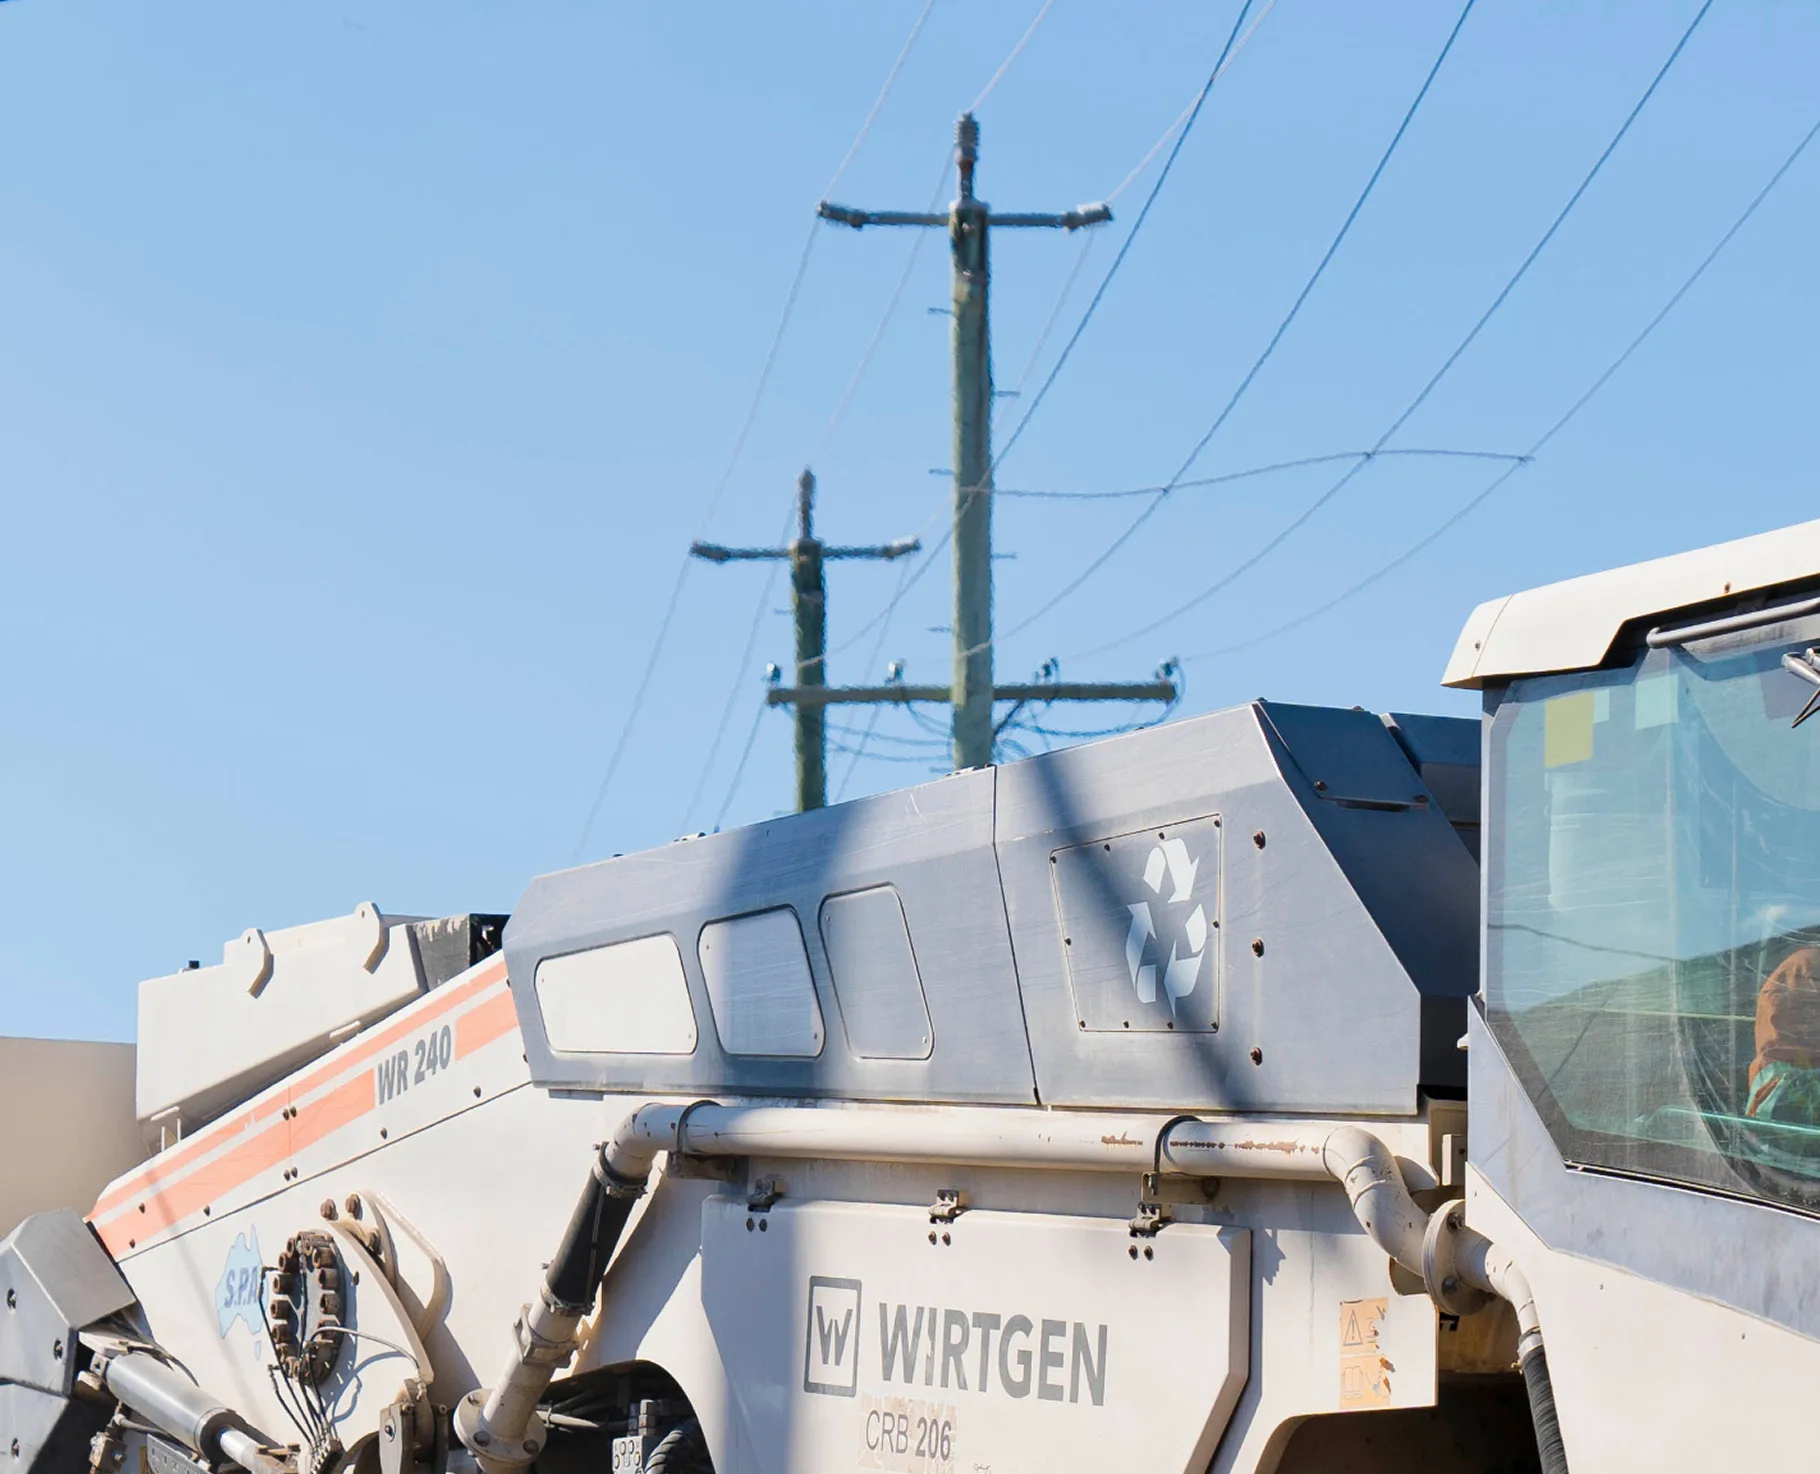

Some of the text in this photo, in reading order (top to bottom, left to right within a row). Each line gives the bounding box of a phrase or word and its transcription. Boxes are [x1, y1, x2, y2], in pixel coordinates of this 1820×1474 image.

[378, 1025, 451, 1105] WR 240
[879, 1303, 1108, 1407] WIRTGEN
[865, 1410, 952, 1461] CRB 206
